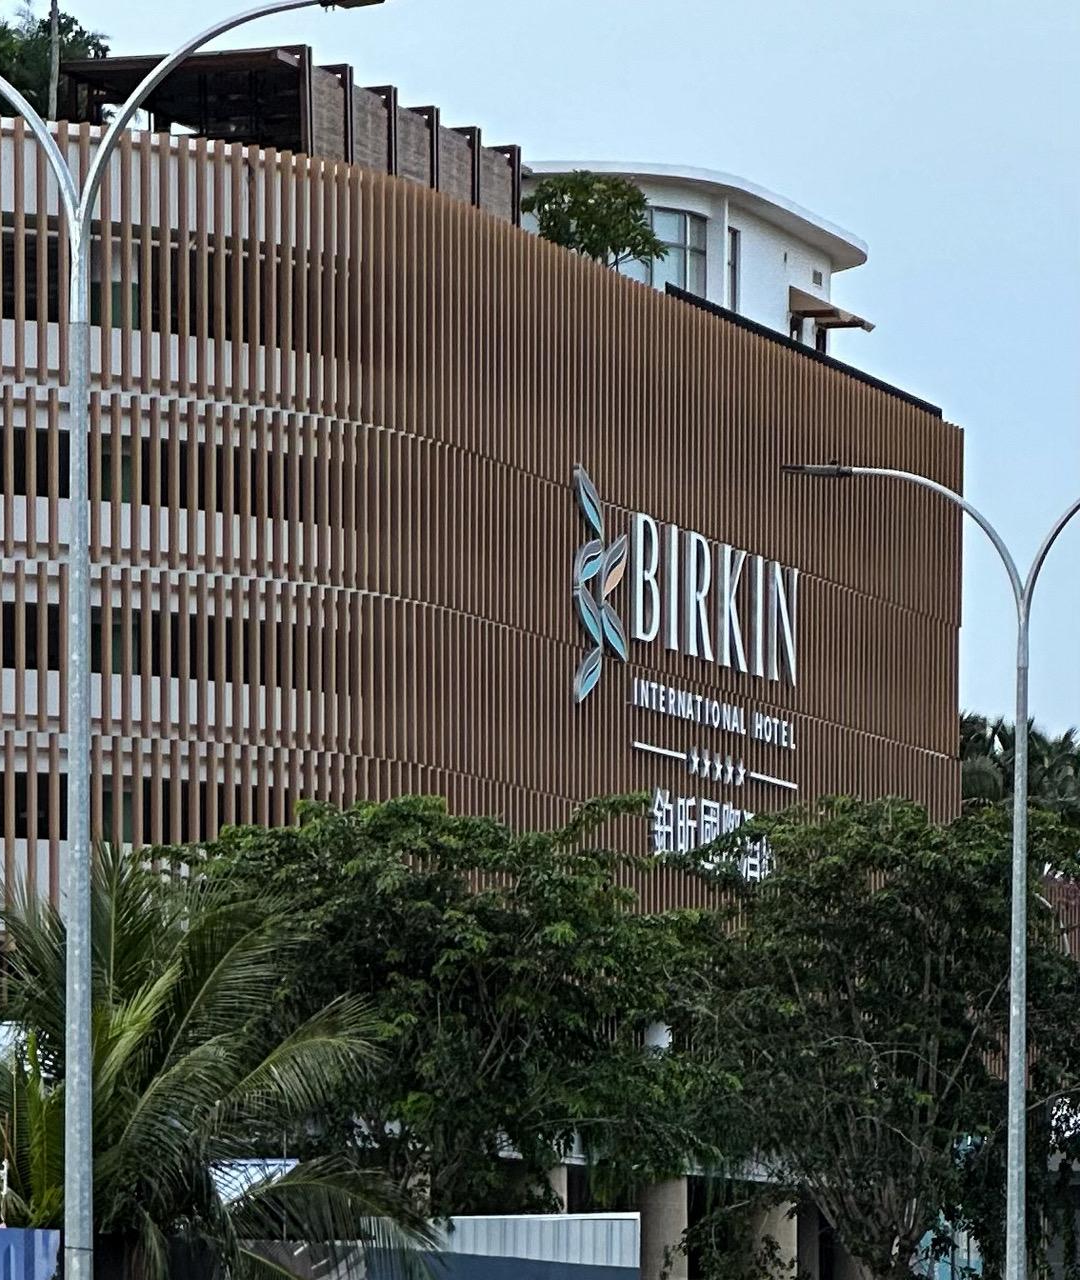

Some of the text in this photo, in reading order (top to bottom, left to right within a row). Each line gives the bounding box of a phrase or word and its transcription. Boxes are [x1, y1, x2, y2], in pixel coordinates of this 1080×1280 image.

[632, 512, 798, 687] BIRKIN
[633, 677, 796, 750] INTERNATIONAL HOTEL
